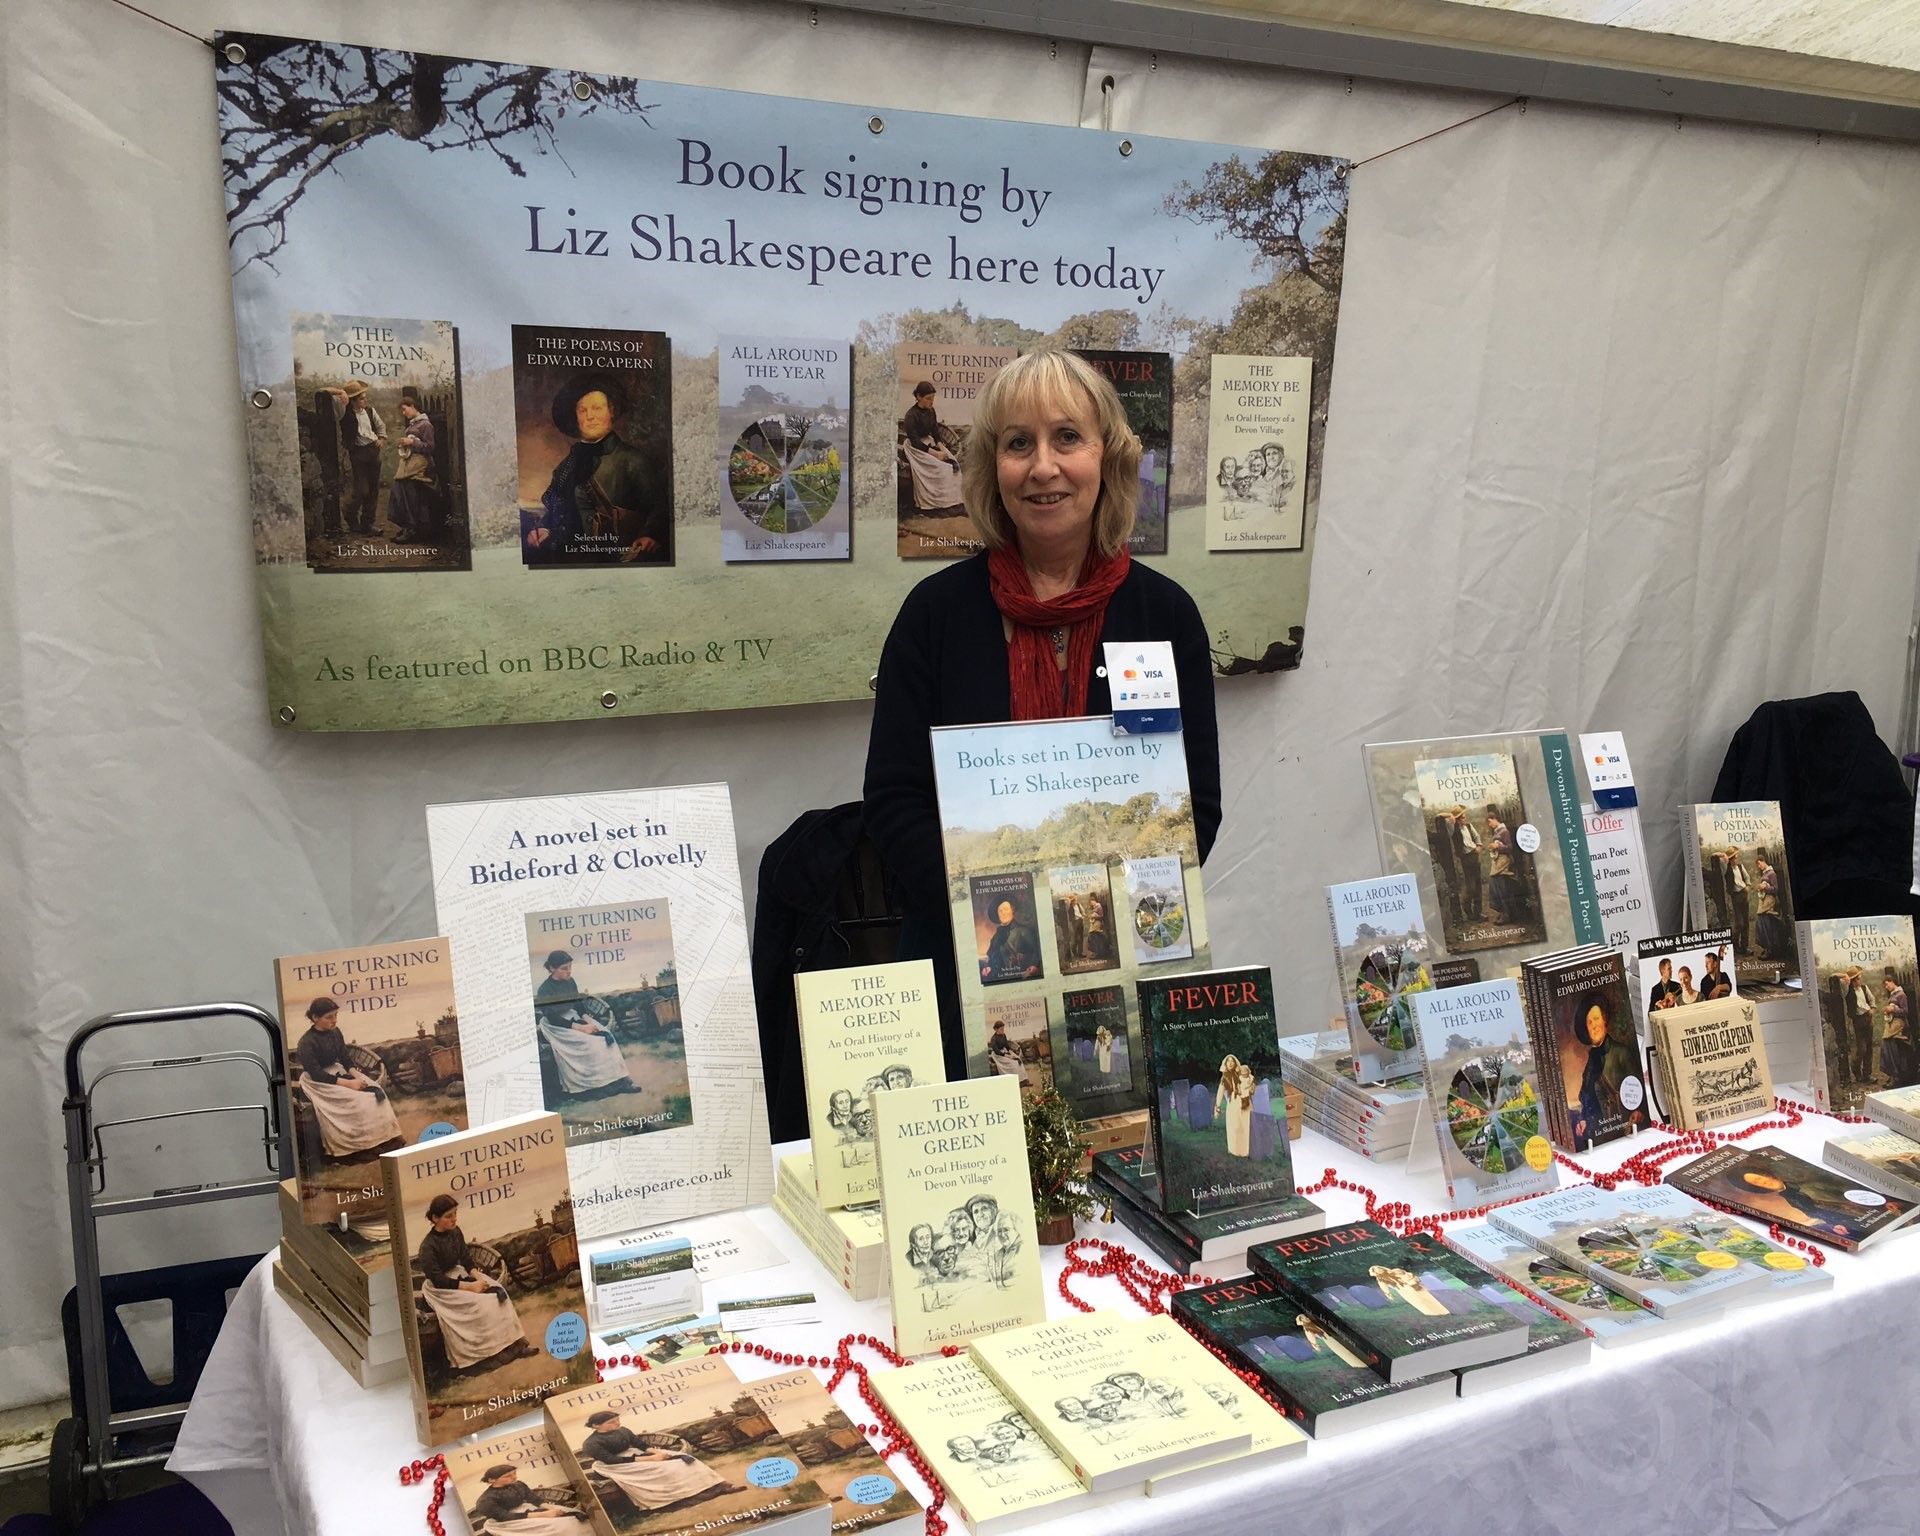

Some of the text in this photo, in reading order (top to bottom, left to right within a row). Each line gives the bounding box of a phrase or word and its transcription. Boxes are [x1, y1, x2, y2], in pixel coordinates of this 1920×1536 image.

[677, 138, 1052, 228] Book signing by
[525, 205, 1166, 304] Liz Shakespeare here today
[352, 326, 392, 342] THE
[325, 342, 424, 361] POSTMAN
[536, 337, 644, 352] THE POEMS OF
[527, 353, 654, 369] EDWARD CAPERN
[731, 346, 837, 362] ALL AROUND
[908, 353, 1008, 368] THE TURNING
[350, 361, 401, 377] POET
[745, 365, 825, 380] THE YEAR
[932, 371, 985, 384] OF THE
[1249, 365, 1273, 376] THE
[941, 387, 976, 399] TIDE
[1222, 380, 1300, 392] MEMORY BE
[1238, 396, 1282, 407] GREEN
[745, 539, 826, 552] Liz Shakespeare
[919, 537, 934, 547] Liz
[1225, 533, 1286, 542] Liz Shakespeare
[338, 544, 438, 558] Liz Shakespeare
[315, 638, 774, 682] As featured on BBC Radio & TV
[957, 738, 1162, 769] Books set in Devon by
[1608, 756, 1620, 764] VISA
[1452, 763, 1479, 775] THE
[990, 771, 1140, 796] Liz Shakespeare
[1436, 774, 1498, 790] POSTMAN
[1453, 788, 1487, 802] POET
[1591, 816, 1623, 833] Offer
[508, 818, 667, 850] A novel set in
[1552, 748, 1592, 935] Devonshire's Postman Poet
[1609, 848, 1628, 859] Poet
[470, 844, 707, 885] Bideford & Clovelly
[1603, 868, 1630, 881] Poems
[1620, 884, 1629, 896] of
[1626, 899, 1641, 912] CD
[539, 906, 657, 932] THE TURNING
[570, 929, 633, 948] OF THE
[1463, 926, 1525, 942] Liz Shakespeare
[1850, 924, 1878, 936] THE
[1610, 931, 1630, 948] £25
[1639, 941, 1654, 951] Nick
[1654, 938, 1674, 949] Wyke
[1675, 936, 1681, 945] &
[1682, 933, 1701, 945] Becki
[1703, 928, 1731, 941] Driscoll
[1833, 936, 1897, 951] POSTMAN
[585, 949, 626, 966] TIDE
[1849, 950, 1885, 963] POET
[293, 950, 440, 981] THE TURNING
[1559, 962, 1613, 983] THE POEMS OF
[331, 973, 409, 996] OF THE
[1557, 973, 1620, 997] EDWARD CAPERN
[346, 994, 398, 1014] TIDE
[1071, 991, 1115, 1007] FEVER
[1168, 982, 1259, 1012] FEVER
[1429, 989, 1511, 1014] ALL AROUND
[1162, 1022, 1169, 1031] A
[1169, 1021, 1186, 1032] Story
[1187, 1019, 1203, 1029] from
[1209, 1016, 1231, 1027] Devon
[1231, 1012, 1268, 1026] Churchyard
[1441, 1007, 1505, 1029] THE YEAR
[1684, 1020, 1729, 1036] THE SONGS OF
[1680, 1024, 1754, 1058] EDWARD CAPERN
[1690, 1045, 1751, 1066] THE POSTMAN POET
[932, 1095, 969, 1112] THE
[568, 1110, 674, 1138] Liz Shakespeare
[898, 1110, 1007, 1138] MEMORY BE
[924, 1133, 985, 1155] GREEN
[412, 1128, 555, 1180] THE TURNING
[450, 1158, 526, 1192] OF THE
[907, 1166, 922, 1179] An
[924, 1162, 947, 1176] Oral
[950, 1159, 987, 1175] History
[989, 1155, 1001, 1165] of
[572, 1164, 733, 1208] izshakespeare.co.uk
[924, 1174, 993, 1191] Devon Village
[1191, 1179, 1274, 1200] Liz Shakespeare
[465, 1182, 516, 1209] TIDE
[1278, 1227, 1376, 1258] FEVER
[556, 1318, 578, 1328] A novel
[927, 1315, 1022, 1342] Liz Shakespeare
[553, 1336, 579, 1346] Bideford
[1404, 1320, 1497, 1348] Liz Shakespeare
[557, 1344, 581, 1354] Clovelly
[462, 1374, 569, 1421] Liz Shakespeare
